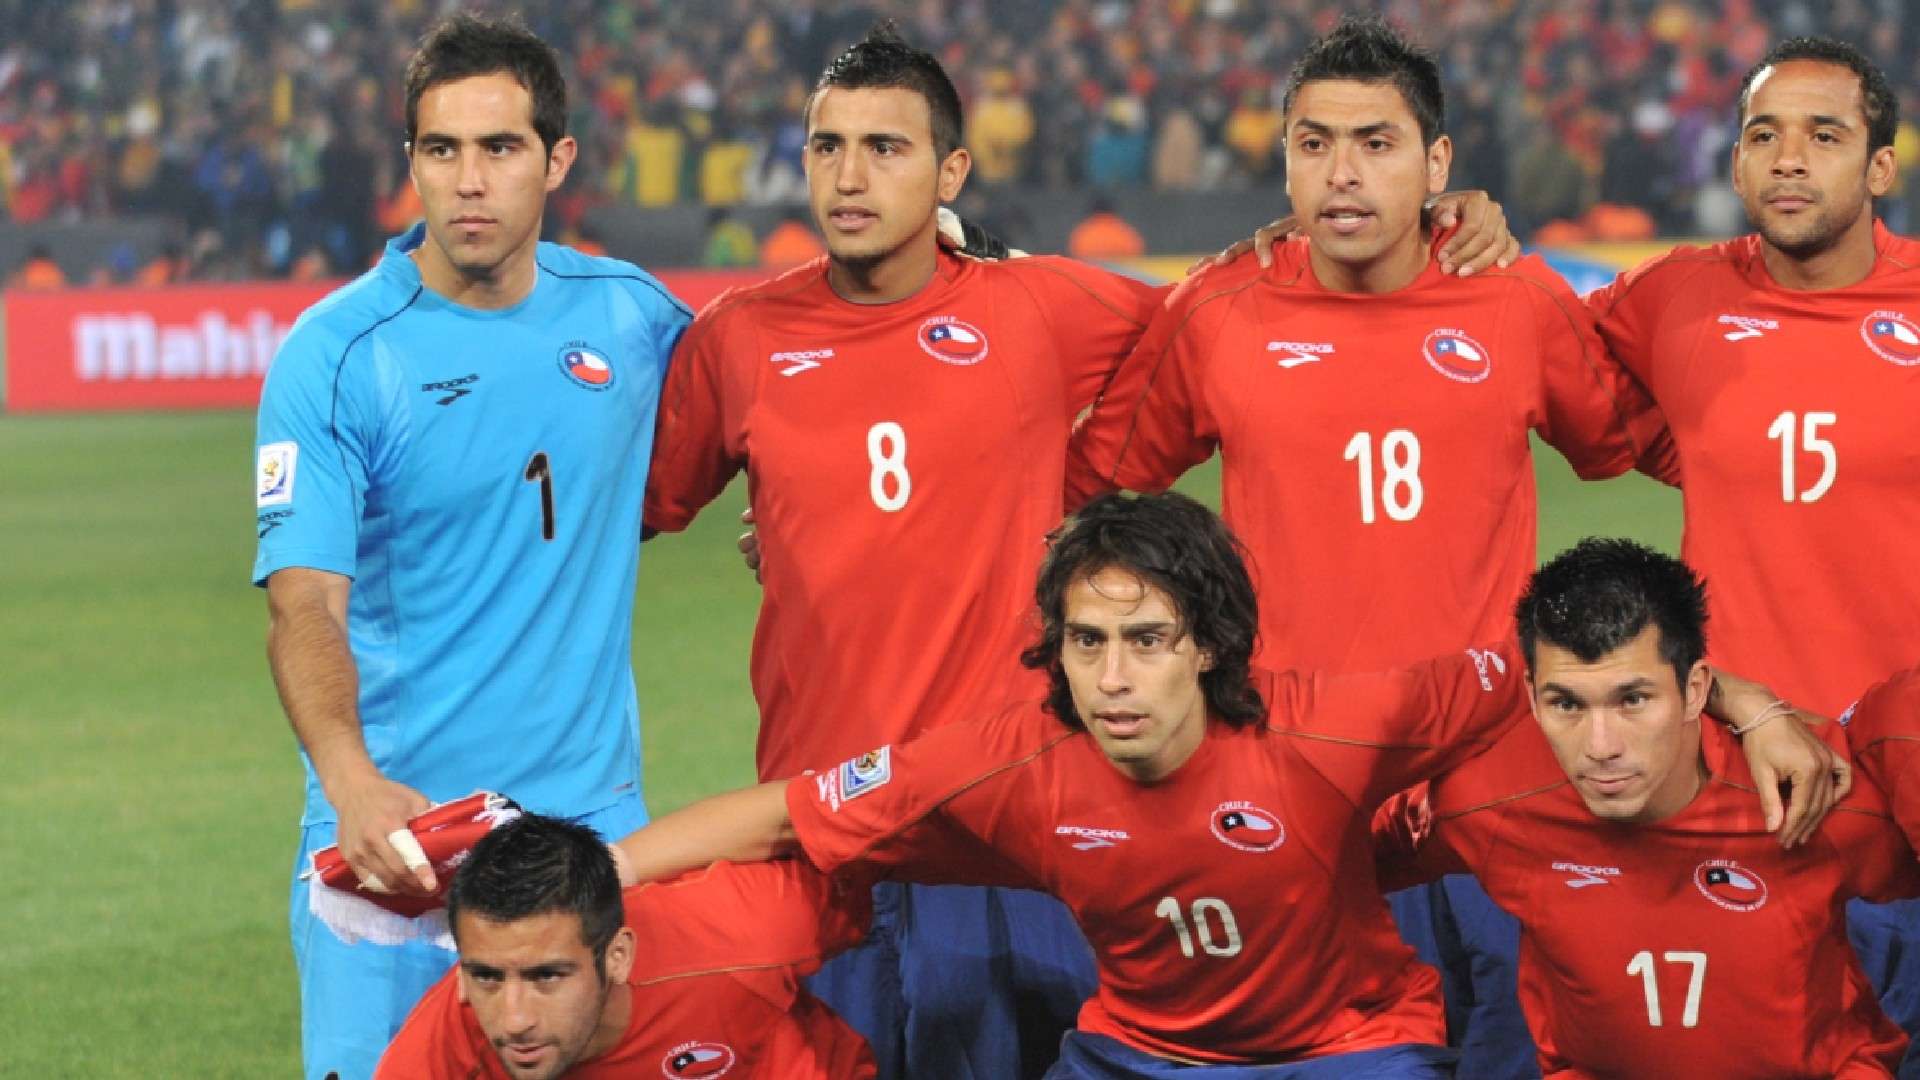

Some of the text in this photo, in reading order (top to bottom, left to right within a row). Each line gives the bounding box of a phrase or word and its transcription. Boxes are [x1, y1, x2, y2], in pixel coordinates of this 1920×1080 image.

[525, 451, 555, 541] 1
[866, 421, 913, 513] 8
[1343, 428, 1424, 524] 18
[1767, 409, 1838, 504] 15
[1056, 826, 1128, 840] BROOKS
[1552, 862, 1621, 875] BROOKS
[1156, 896, 1242, 957] 10
[1626, 950, 1708, 1027] 17
